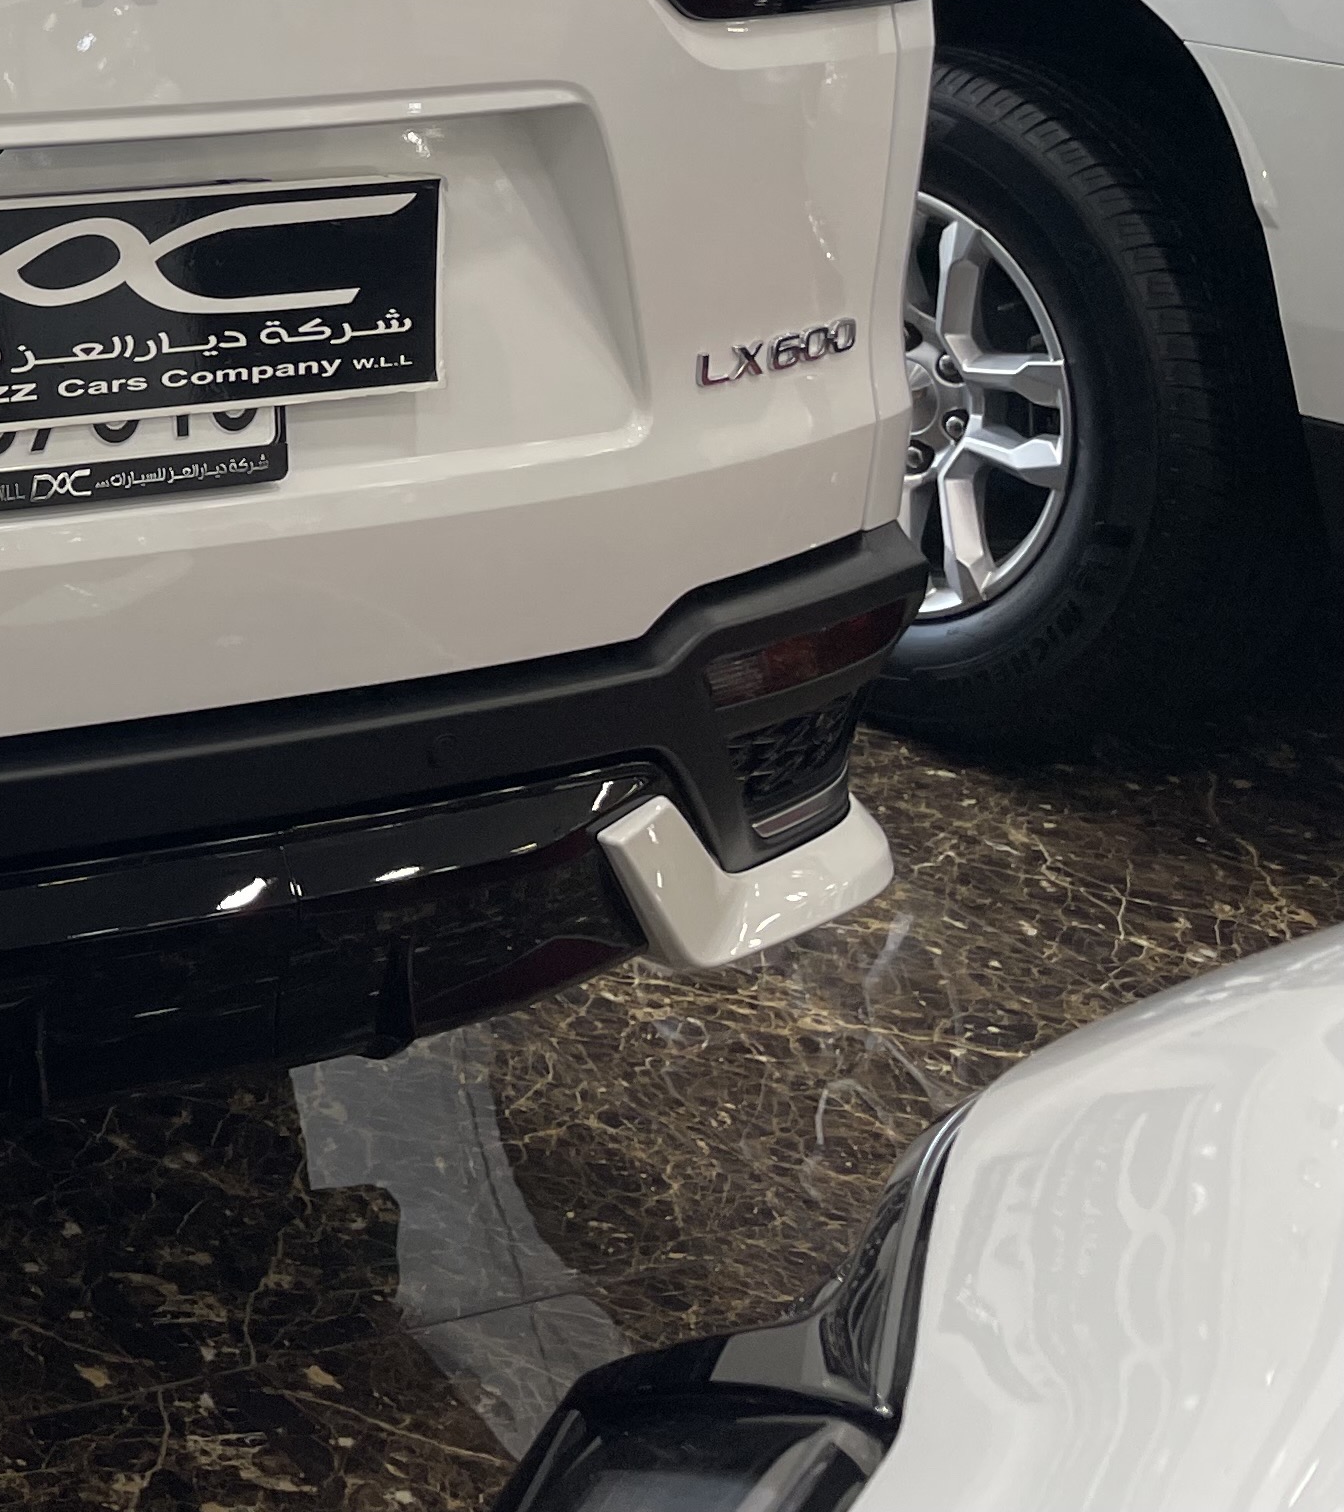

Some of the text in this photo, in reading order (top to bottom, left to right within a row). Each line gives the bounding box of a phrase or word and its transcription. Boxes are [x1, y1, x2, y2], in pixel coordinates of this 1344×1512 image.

[259, 308, 413, 345] شركة
[57, 374, 148, 399] Cars
[161, 358, 342, 387] Company
[228, 453, 269, 474] شركة
[112, 468, 166, 489] للسيارات
